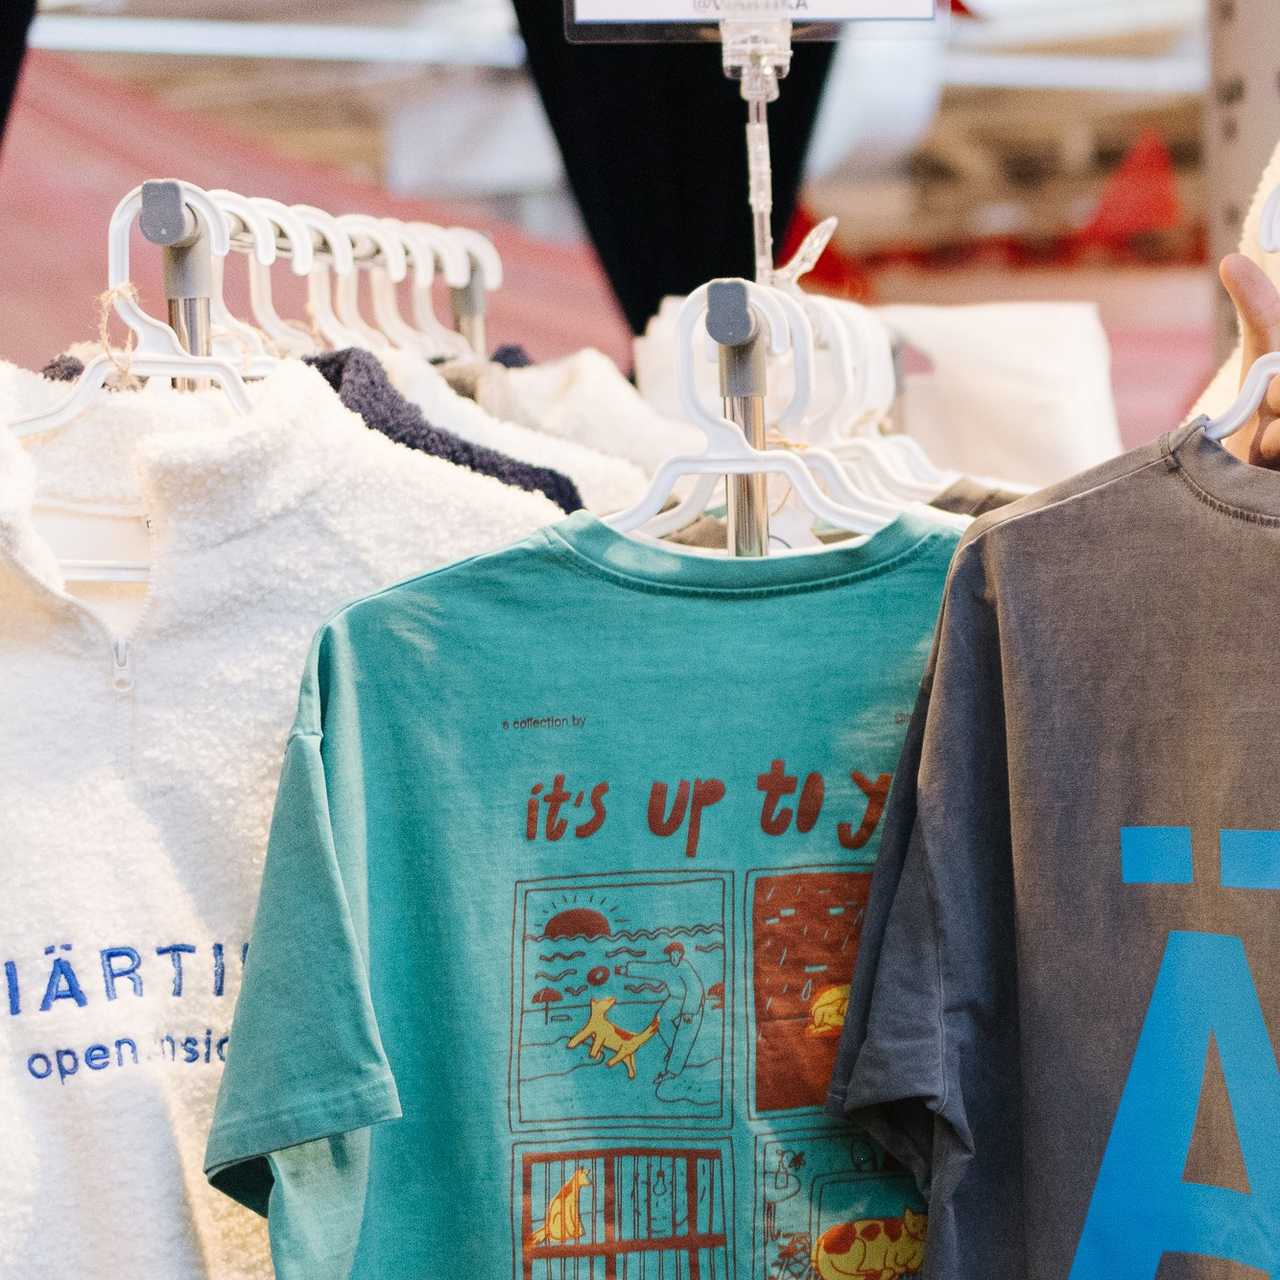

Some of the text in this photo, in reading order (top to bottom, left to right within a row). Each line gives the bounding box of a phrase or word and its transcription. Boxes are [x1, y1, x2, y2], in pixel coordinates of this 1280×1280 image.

[502, 715, 587, 731] a collection by
[526, 774, 609, 841] it's
[647, 777, 725, 857] up
[757, 759, 825, 836] to
[4, 943, 250, 1016] IÄRTI
[27, 1037, 139, 1085] open
